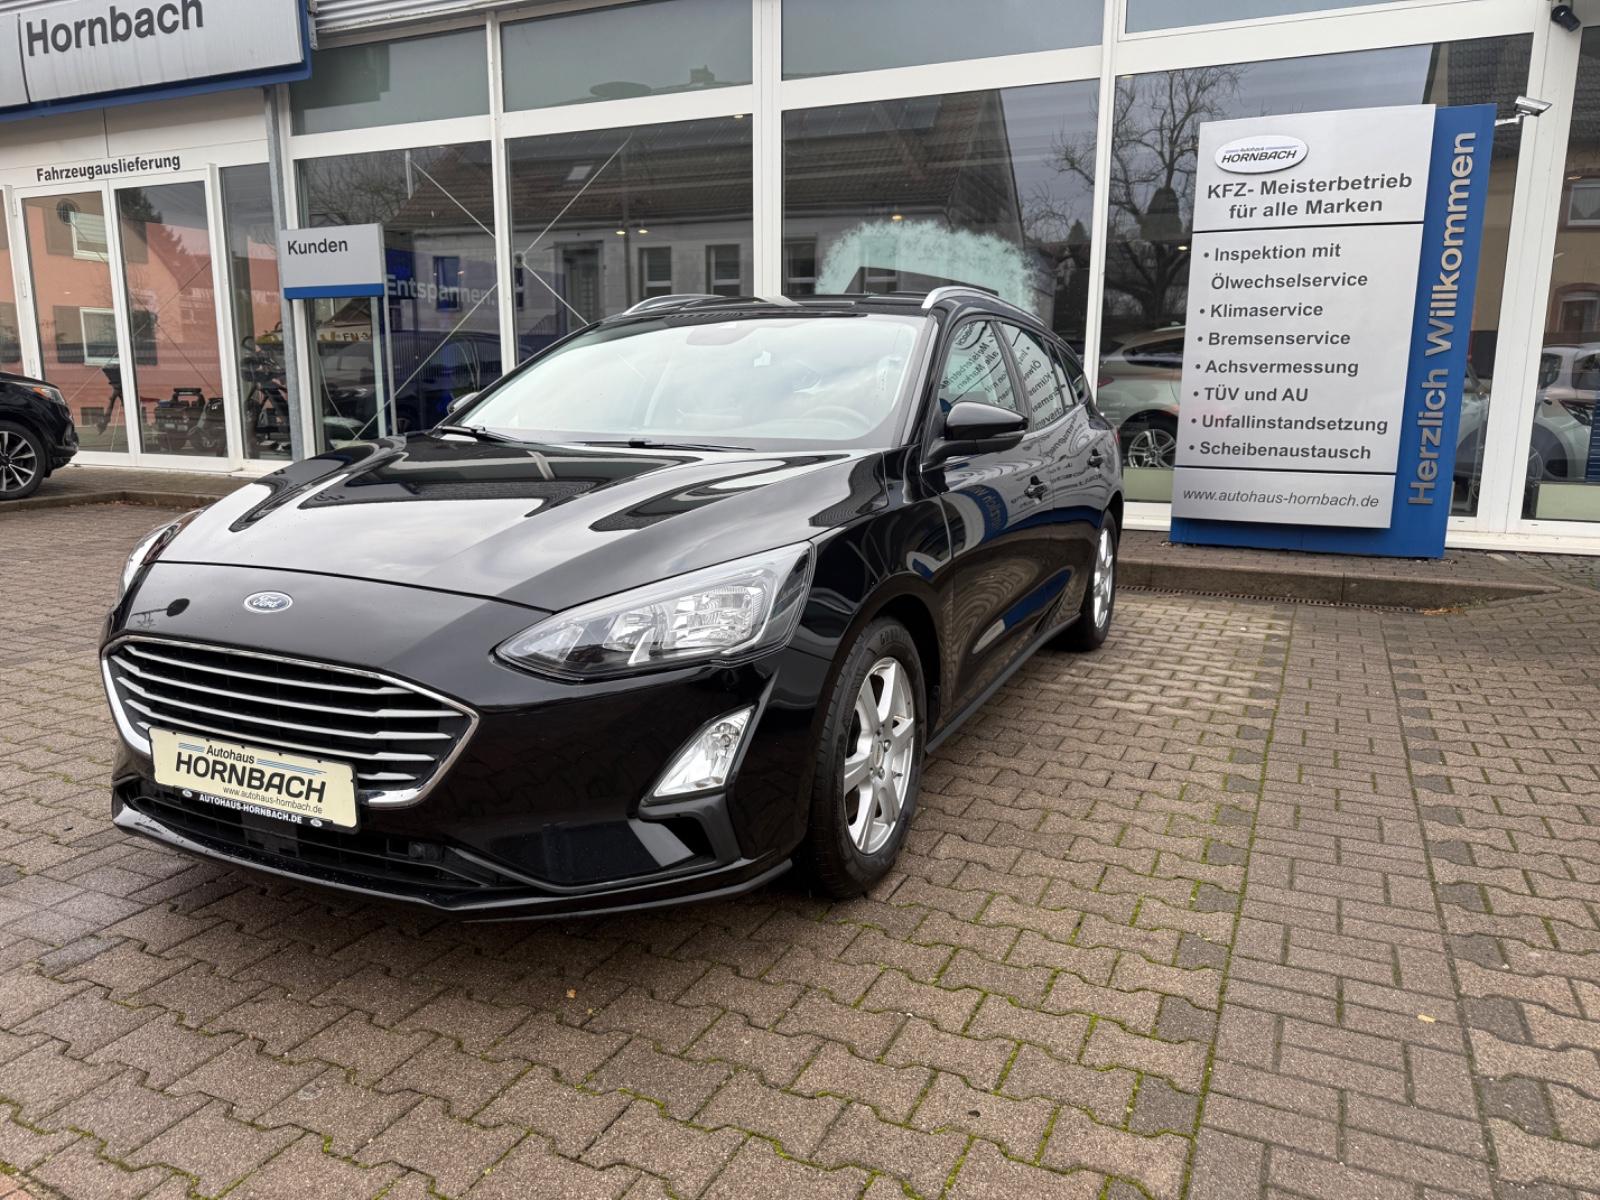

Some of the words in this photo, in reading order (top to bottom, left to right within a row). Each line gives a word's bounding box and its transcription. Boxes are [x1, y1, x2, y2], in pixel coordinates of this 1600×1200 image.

[26, 0, 203, 56] Hornbach
[1221, 150, 1298, 163] HORNBACH
[36, 154, 181, 182] Fahrzeugauslieferung
[1207, 182, 1254, 200] KFZ-
[1260, 173, 1412, 196] Meisterbetrieb
[1229, 203, 1257, 219] für
[1263, 202, 1298, 217] alle
[1305, 197, 1383, 215] Marken
[288, 238, 348, 255] Kunden
[1214, 245, 1306, 265] Inspektion
[1312, 243, 1341, 259] mit
[1425, 131, 1477, 356] Willkommen
[1211, 272, 1368, 290] Ölwechselservice
[1210, 302, 1323, 318] Klimaservice
[1208, 332, 1351, 346] Bremsenservice
[1204, 359, 1359, 377] Achsvermessung
[1204, 383, 1239, 401] TÜV
[1244, 387, 1276, 402] und
[1281, 387, 1309, 402] AU
[1201, 414, 1389, 435] Unfallinstandsetzung
[1408, 368, 1449, 505] Herzlich
[1199, 440, 1372, 460] Scheibenaustausch
[1183, 487, 1380, 508] www.autohaus-hornbach.de
[206, 745, 255, 765] Autohaus
[175, 751, 327, 803] HORNBACH
[199, 794, 303, 825] AUTOHAUS-HORNBACH.DE
[223, 786, 323, 814] www.autohaus-hornbach.de
